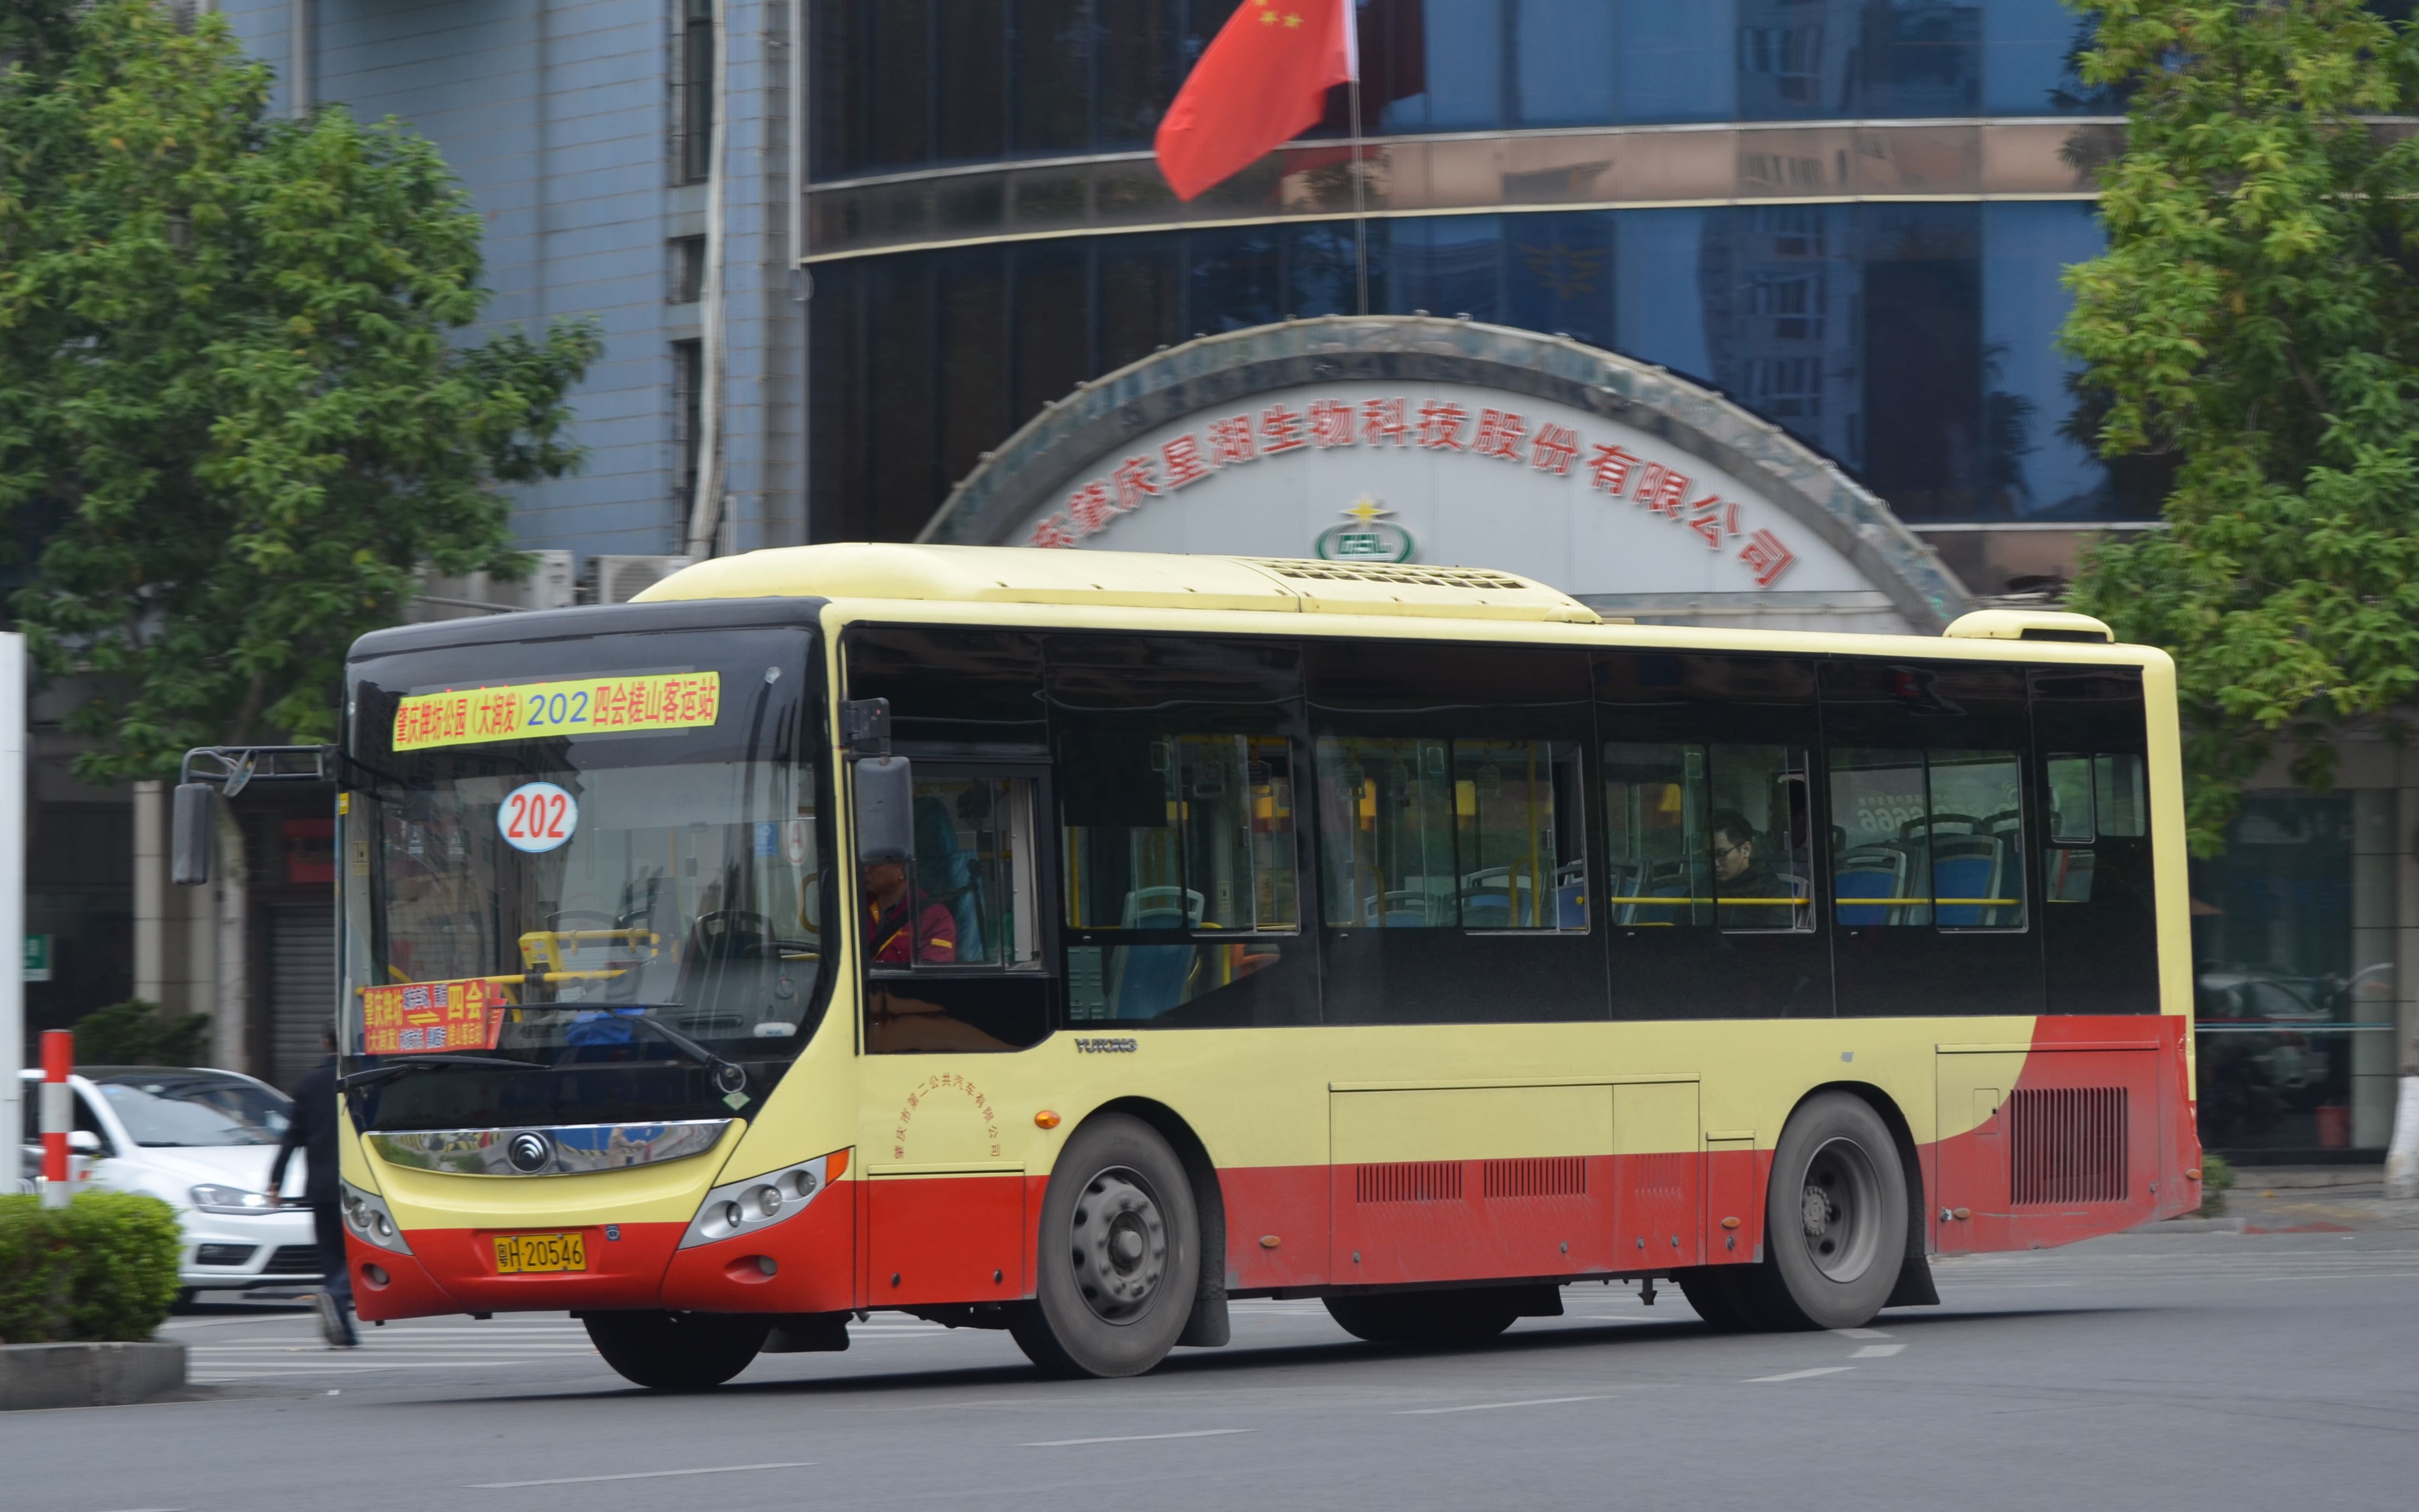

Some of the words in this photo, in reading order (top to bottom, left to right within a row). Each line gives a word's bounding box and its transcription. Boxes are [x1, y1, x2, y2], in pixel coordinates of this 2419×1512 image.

[527, 690, 589, 726] 202
[508, 794, 567, 838] 202
[448, 981, 483, 1020] 四会
[1075, 1038, 1138, 1053] YUTONG
[893, 1072, 1001, 1160] 肇庆市第二公共汽车有限公司
